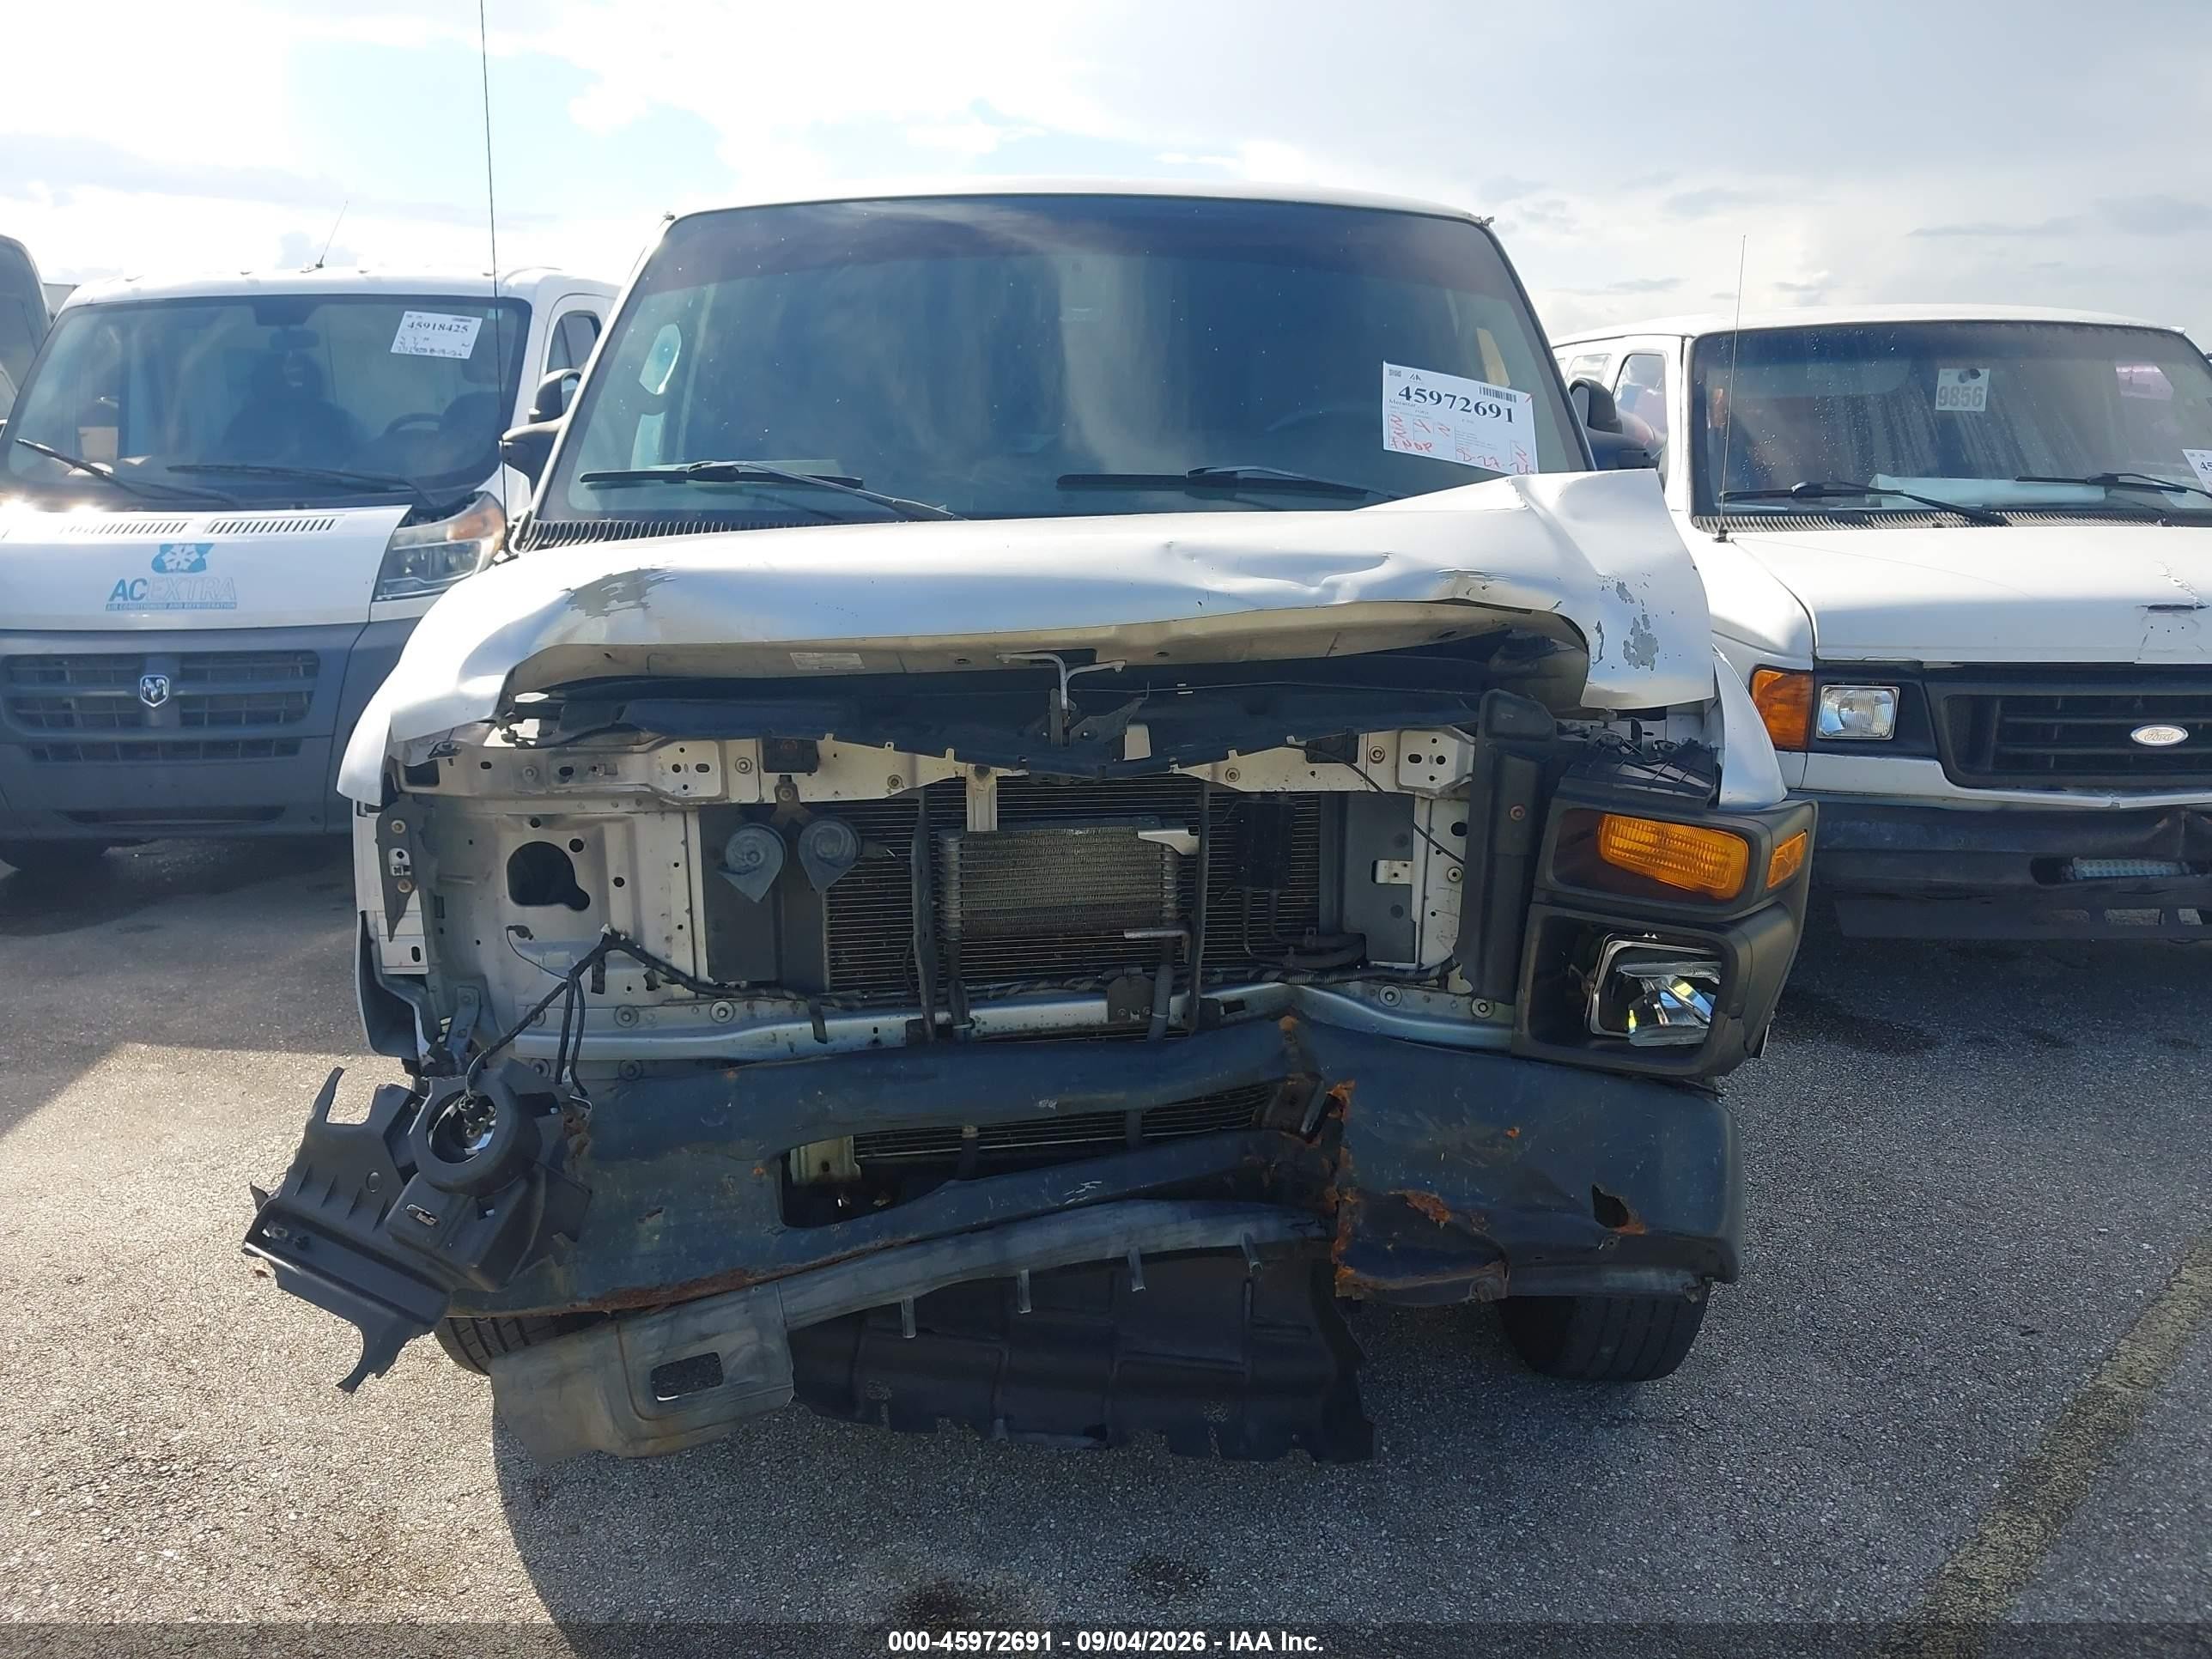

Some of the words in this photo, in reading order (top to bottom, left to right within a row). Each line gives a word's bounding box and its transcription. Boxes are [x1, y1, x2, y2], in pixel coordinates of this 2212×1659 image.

[406, 321, 468, 333] 45918425
[1398, 385, 1514, 424] 45972691
[1938, 386, 1984, 407] 9856
